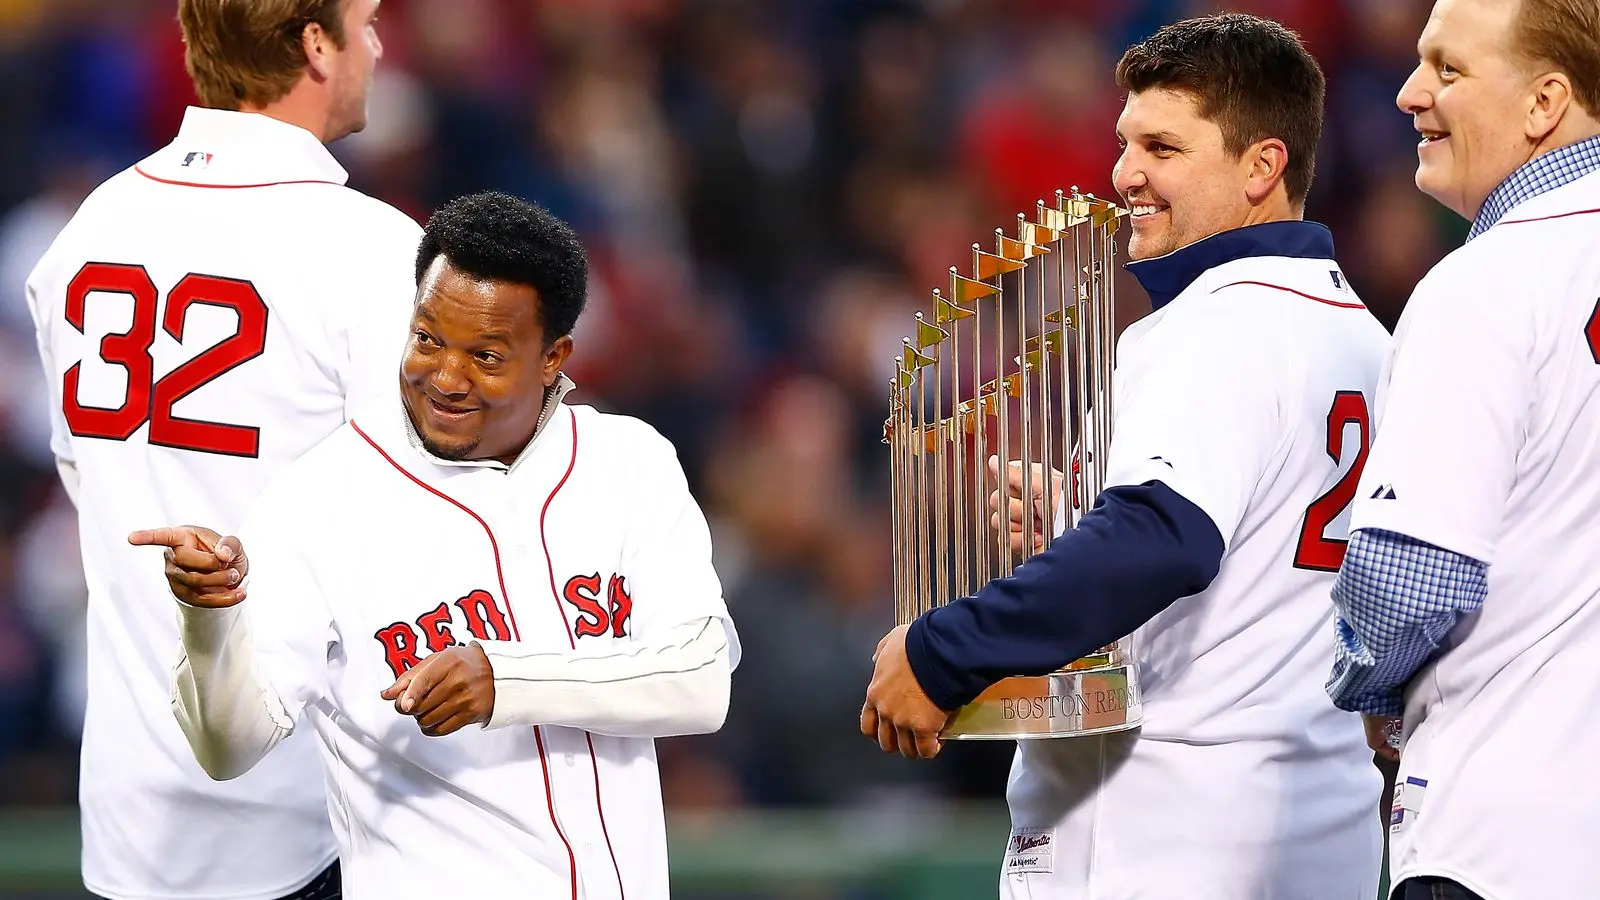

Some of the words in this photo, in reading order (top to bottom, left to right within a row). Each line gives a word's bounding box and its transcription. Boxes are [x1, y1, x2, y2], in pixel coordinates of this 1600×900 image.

[62, 261, 269, 459] 32
[374, 589, 511, 681] RED
[1000, 691, 1091, 720] BOSTON
[1094, 687, 1126, 715] RED
[1127, 683, 1141, 708] SO
